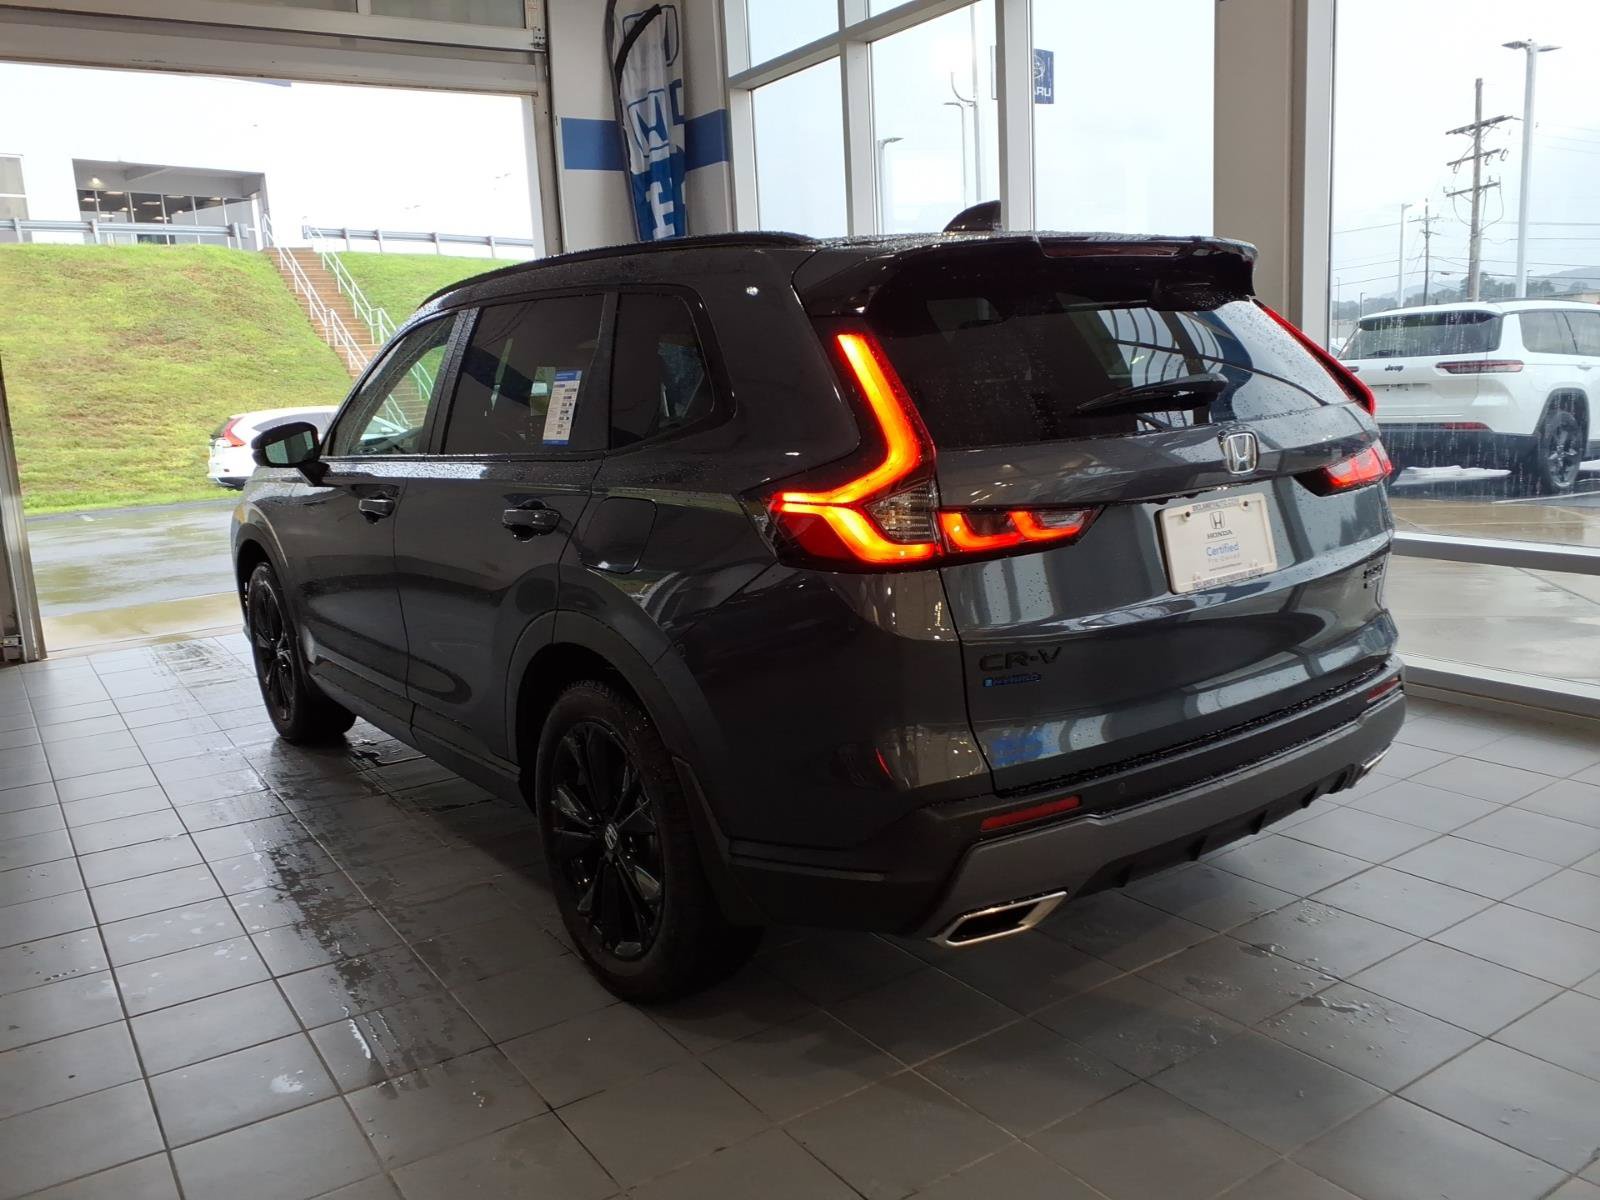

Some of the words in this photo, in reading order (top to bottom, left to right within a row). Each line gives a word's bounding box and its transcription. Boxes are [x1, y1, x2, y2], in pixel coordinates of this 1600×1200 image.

[1207, 529, 1233, 539] HONDA
[1206, 543, 1240, 557] Certified
[979, 646, 1062, 671] CR-V
